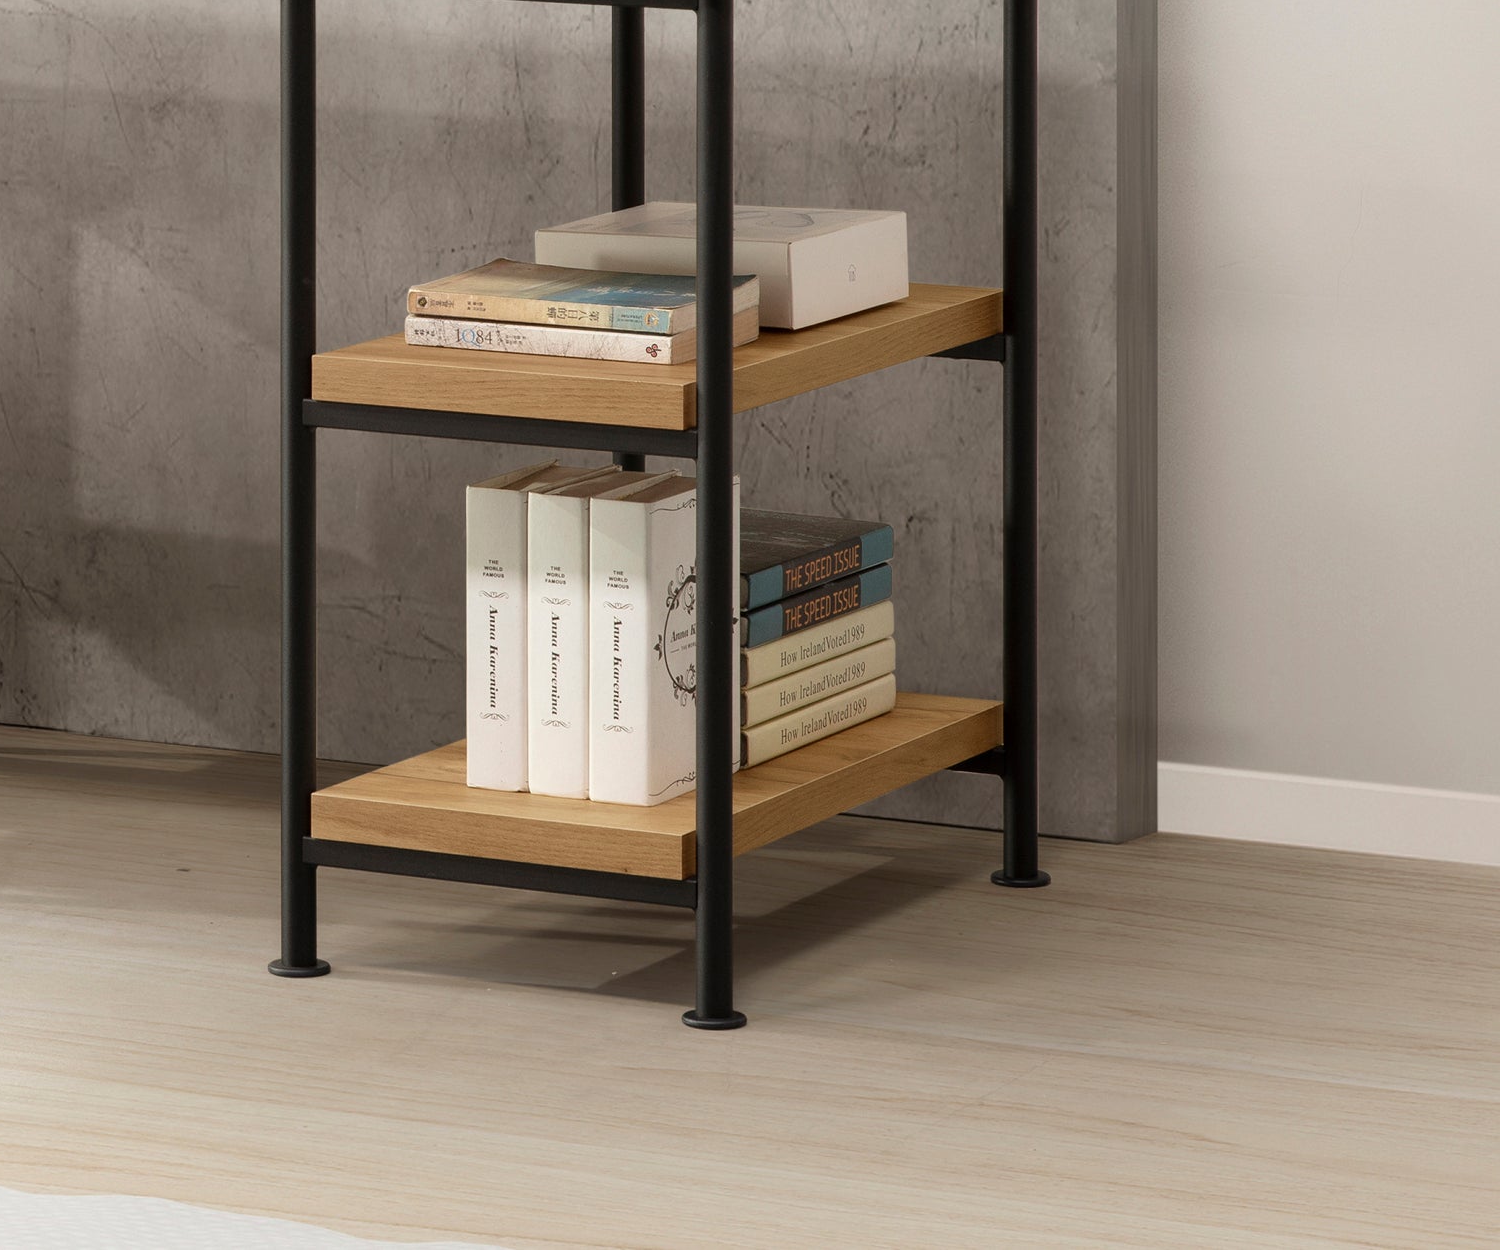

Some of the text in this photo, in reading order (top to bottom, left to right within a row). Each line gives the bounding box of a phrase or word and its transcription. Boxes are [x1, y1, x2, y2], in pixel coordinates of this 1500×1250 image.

[455, 328, 492, 347] 1Q84
[785, 544, 860, 592] THE SPEED ISSUE
[785, 584, 859, 631] THE SPEED ISSUE
[670, 630, 688, 643] Anna
[489, 605, 498, 708] Anna Karenina
[551, 611, 560, 715] Anna Karenina
[613, 616, 622, 720] Anna Karenina
[780, 651, 798, 668] How
[779, 690, 797, 707] How
[781, 728, 798, 745] How
